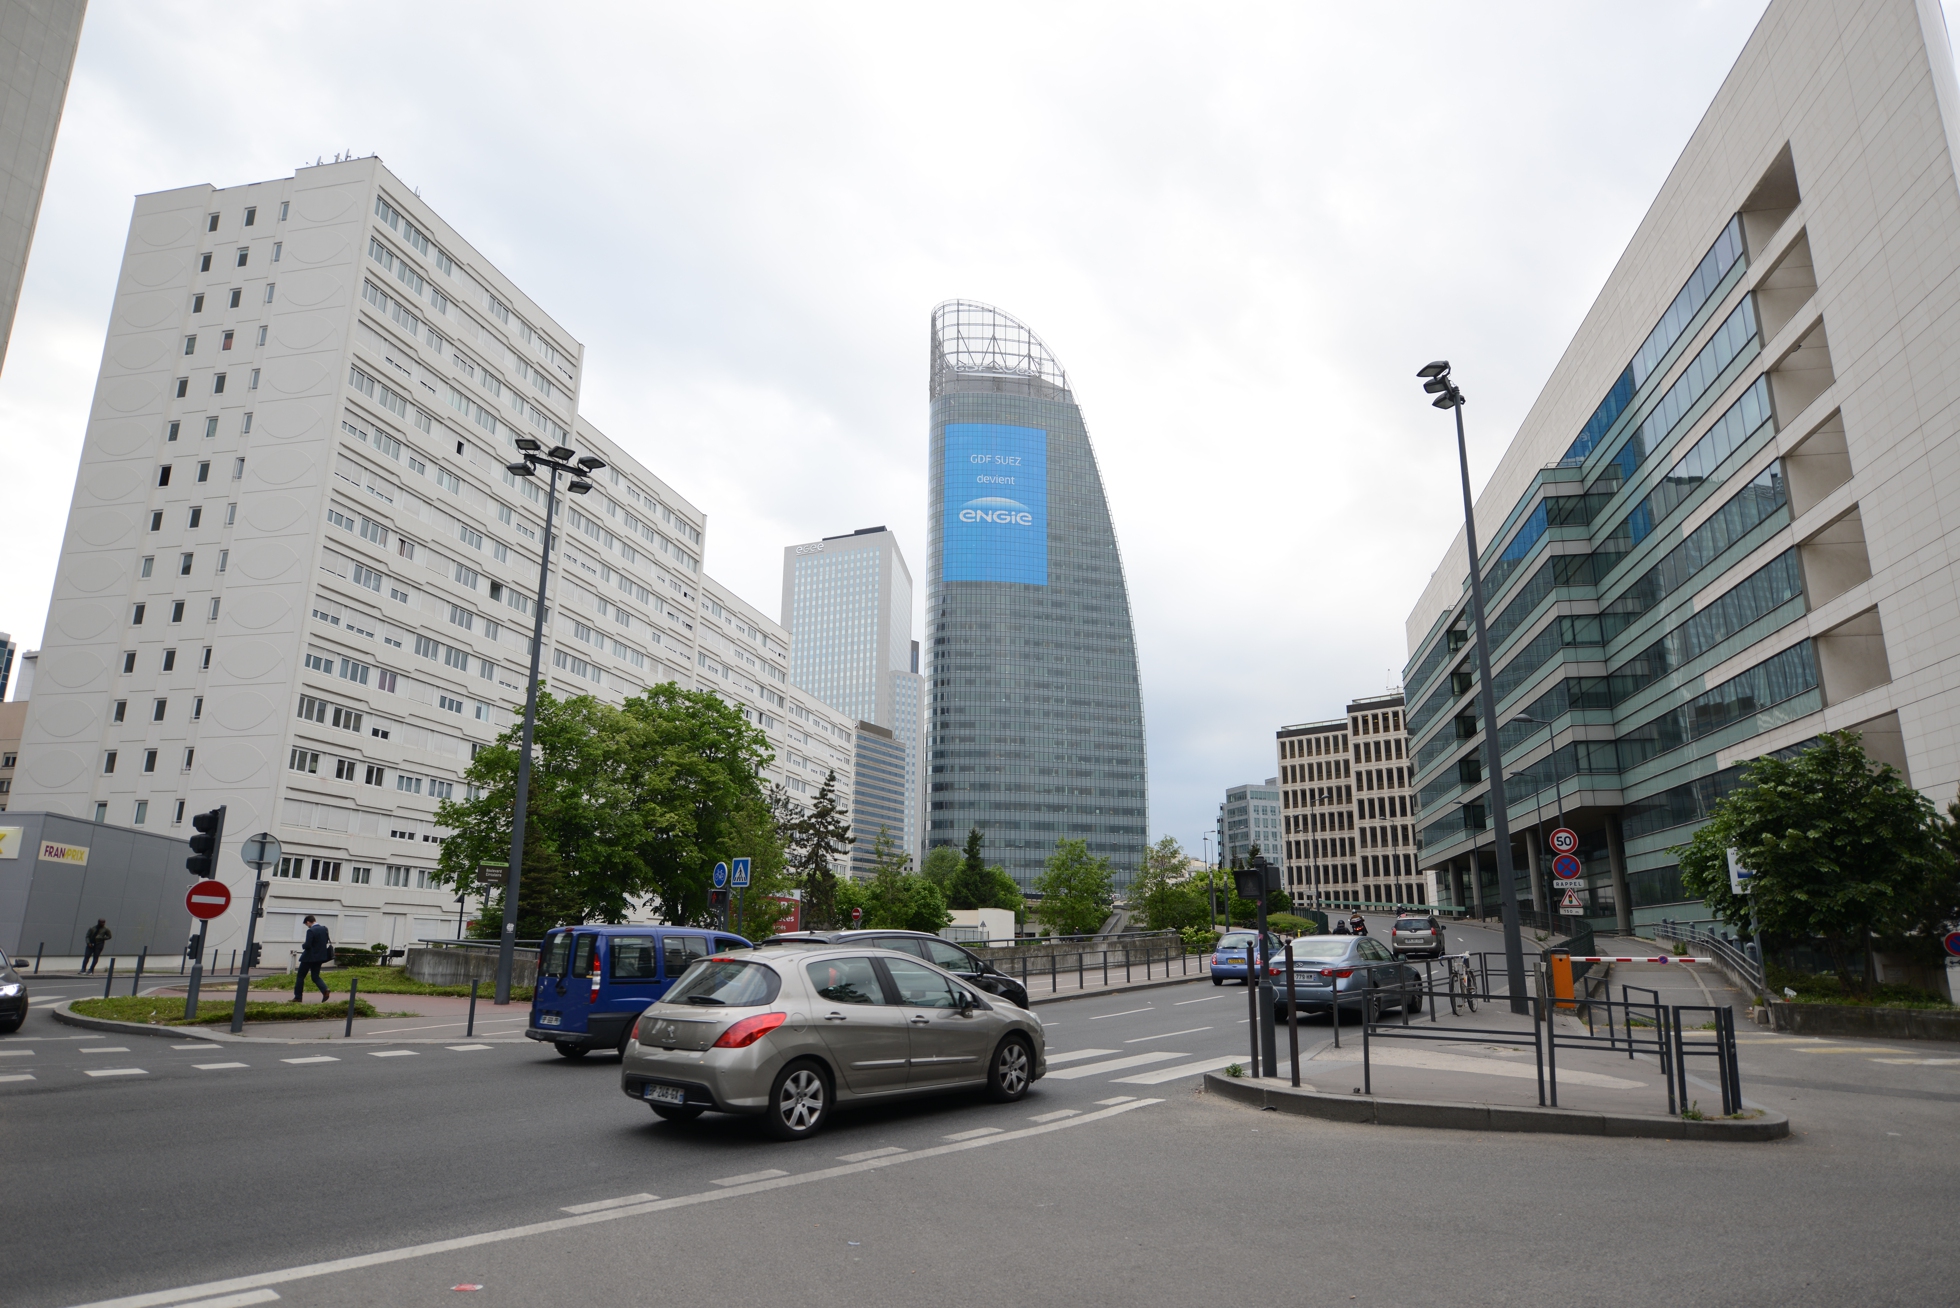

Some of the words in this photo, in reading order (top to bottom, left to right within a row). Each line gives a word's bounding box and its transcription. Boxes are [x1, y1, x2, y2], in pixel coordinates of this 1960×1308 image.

[970, 454, 992, 464] GDF
[995, 455, 1022, 466] SUEZ
[976, 474, 1016, 485] devient
[1556, 835, 1572, 847] 50
